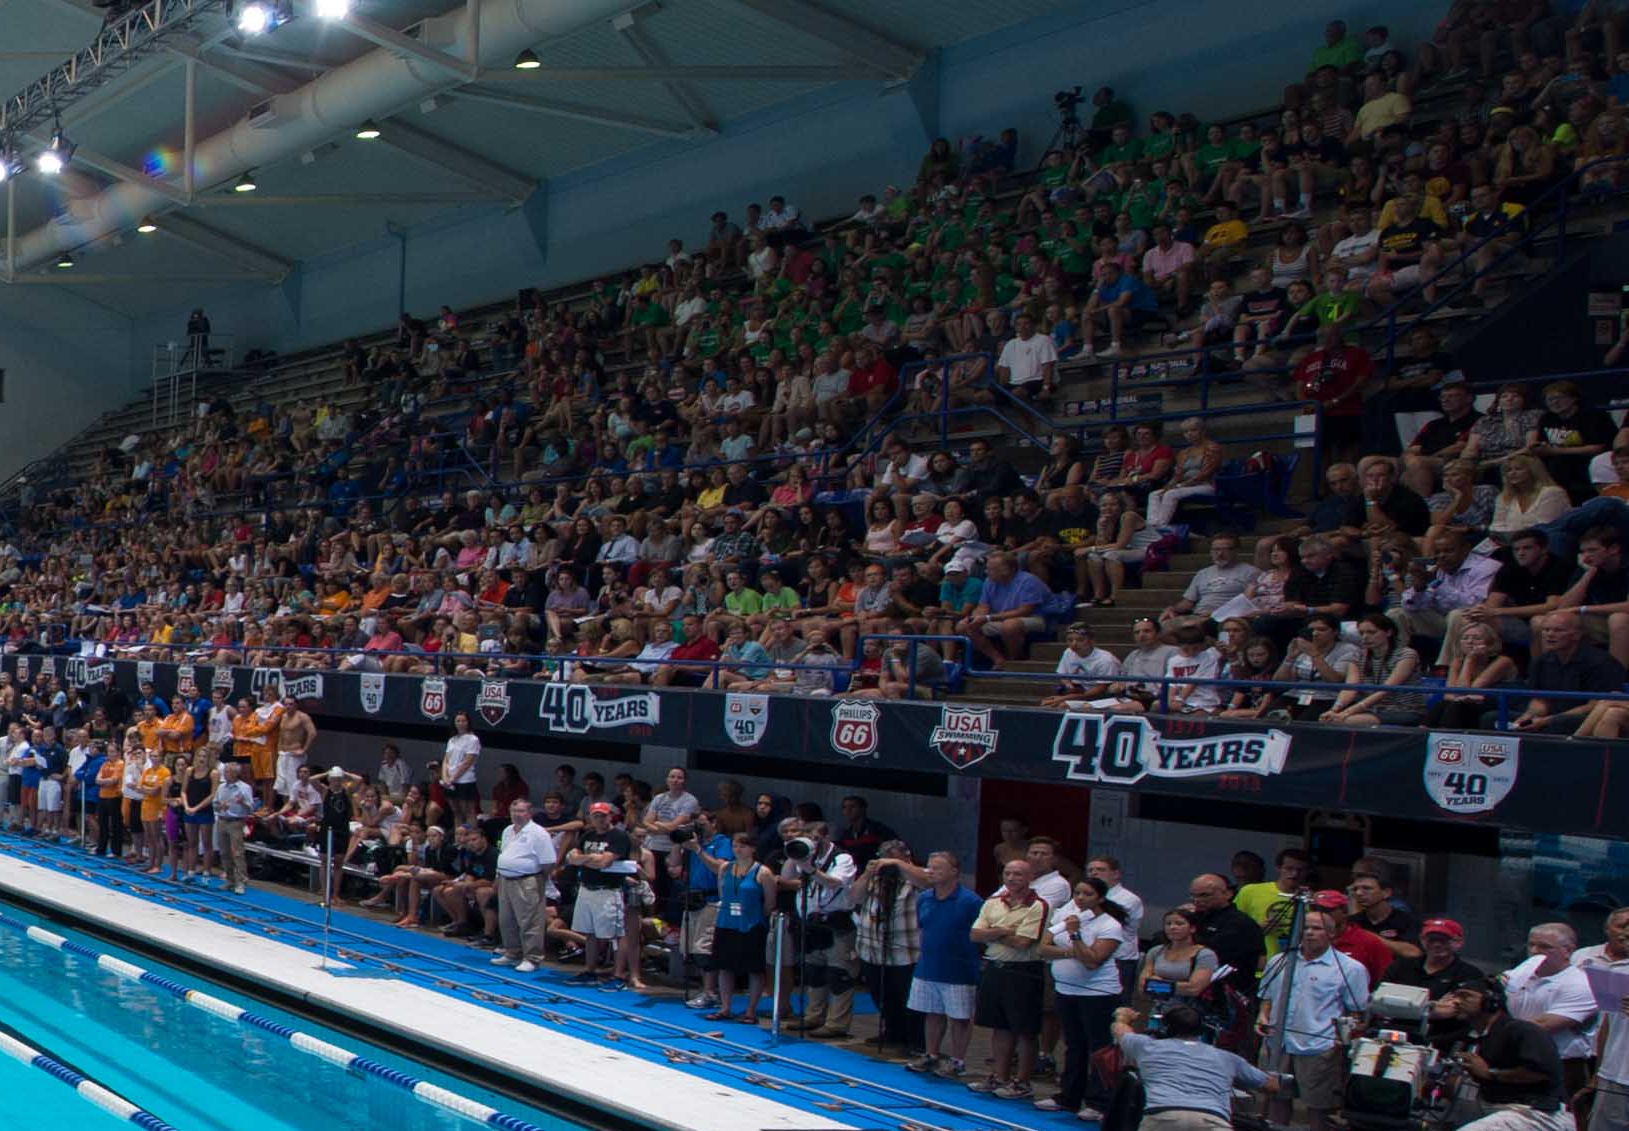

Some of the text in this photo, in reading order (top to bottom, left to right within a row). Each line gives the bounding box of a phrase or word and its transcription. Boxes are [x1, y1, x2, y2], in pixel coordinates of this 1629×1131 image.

[66, 657, 87, 688] 40
[484, 687, 503, 698] USA
[425, 694, 441, 711] 66
[540, 683, 648, 733] 40 YEARS
[839, 708, 872, 720] PHILLIPS
[734, 719, 755, 736] 40
[946, 716, 983, 732] USA
[839, 724, 870, 745] 66
[937, 730, 992, 746] SWIMMING
[1054, 715, 1266, 783] 40 YEARS
[1439, 749, 1458, 760] 66
[1444, 772, 1488, 795] 40
[1445, 796, 1485, 806] YEARS
